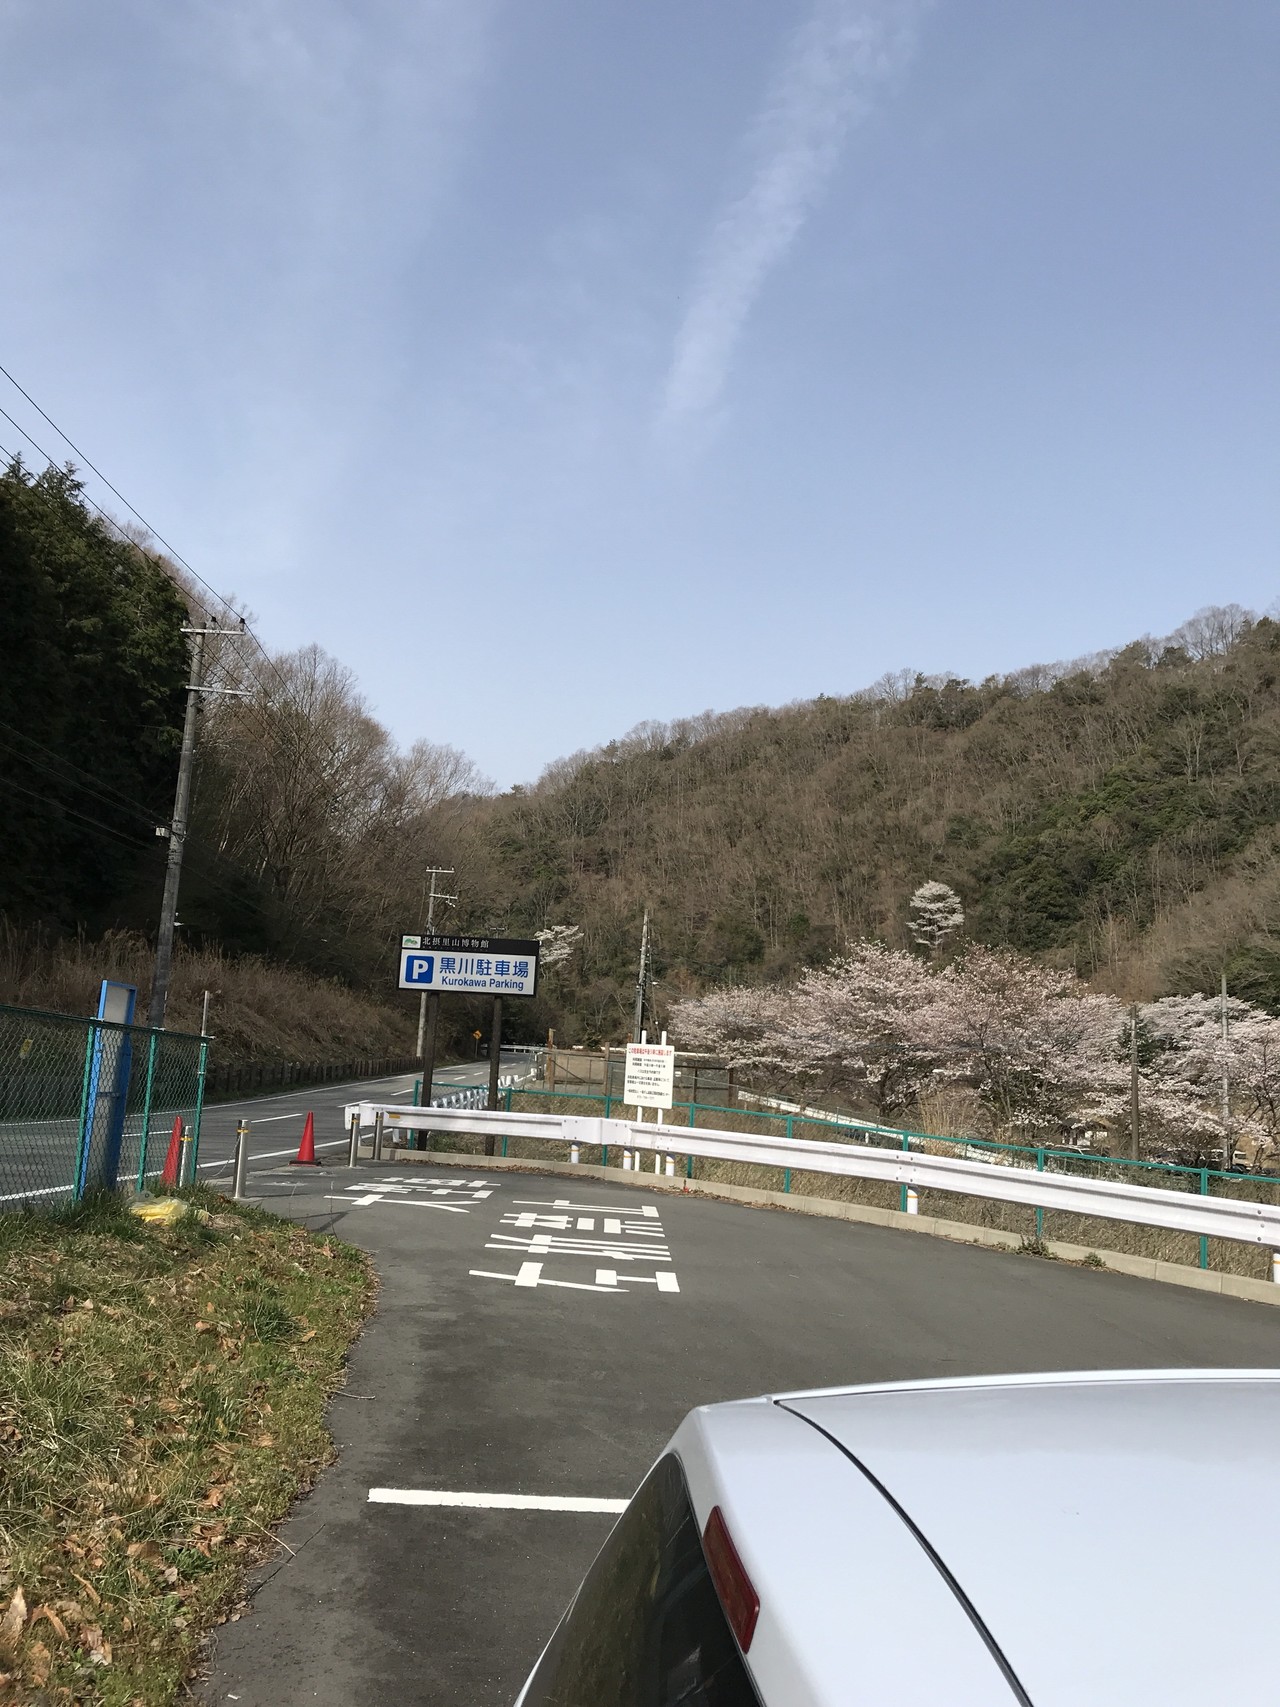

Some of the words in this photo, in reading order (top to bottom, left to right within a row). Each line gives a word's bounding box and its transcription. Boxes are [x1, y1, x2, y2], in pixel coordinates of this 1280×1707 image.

[422, 936, 490, 949] 北摂里山博物館
[412, 959, 429, 979] P
[439, 957, 529, 978] 黒川駐車場
[441, 976, 487, 987] Kurokawa
[489, 979, 524, 991] Parking
[468, 1199, 681, 1293] 左折禁止
